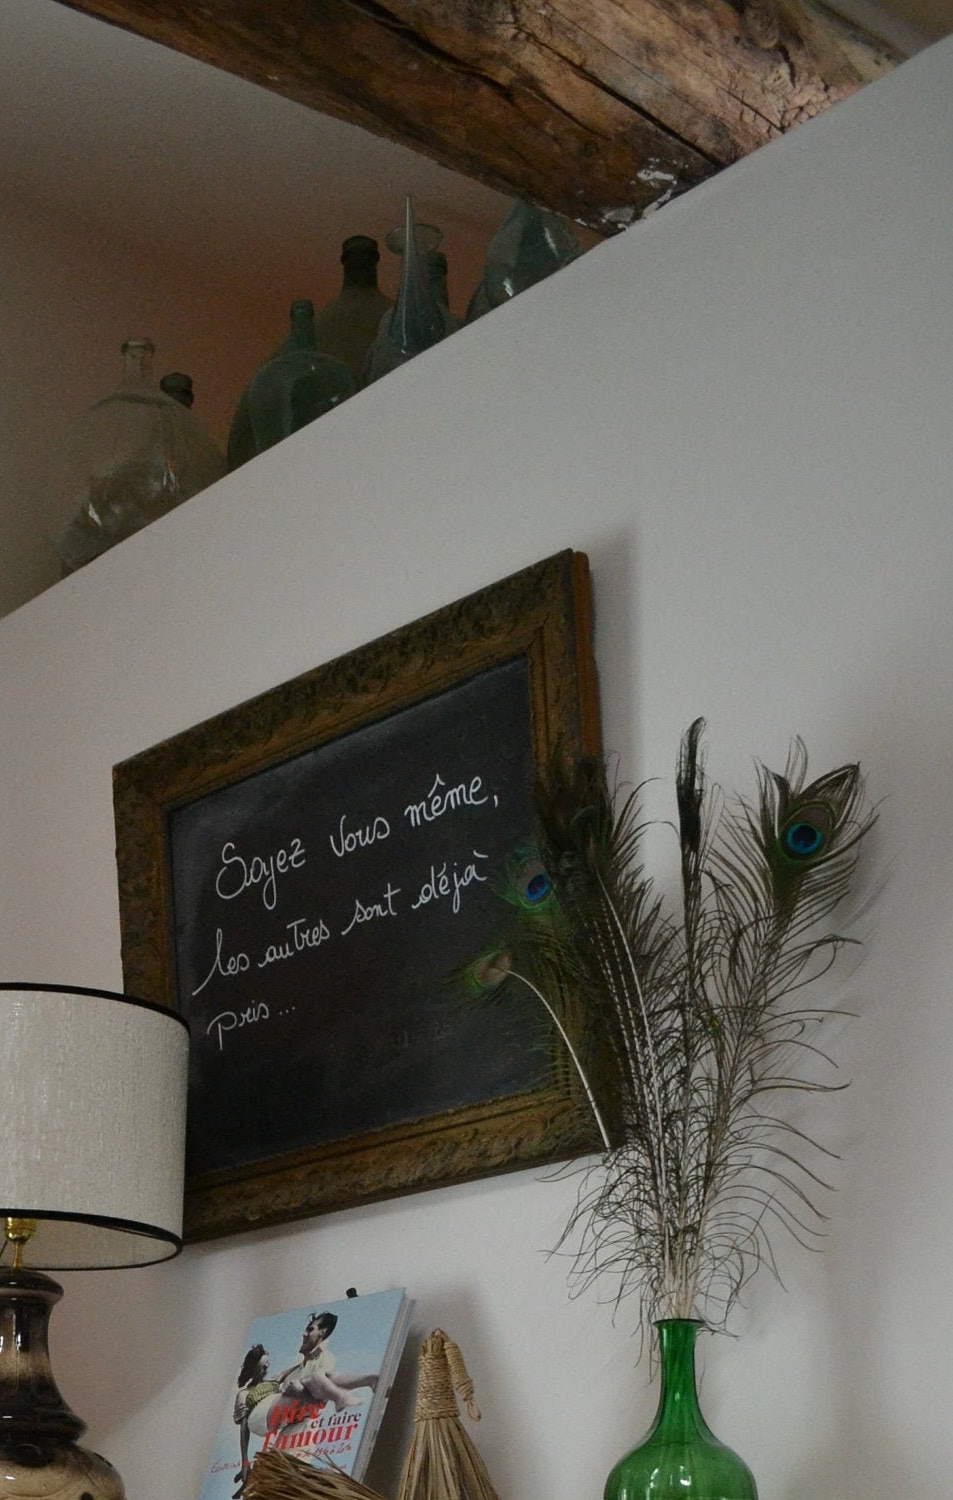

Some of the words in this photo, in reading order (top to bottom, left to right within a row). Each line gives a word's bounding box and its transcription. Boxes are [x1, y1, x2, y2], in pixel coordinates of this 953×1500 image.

[216, 838, 306, 910] Soyez
[404, 773, 498, 827] même,
[341, 883, 401, 935] sont
[411, 850, 488, 913] déjà
[310, 1418, 323, 1429] et
[328, 1411, 362, 1426] faire
